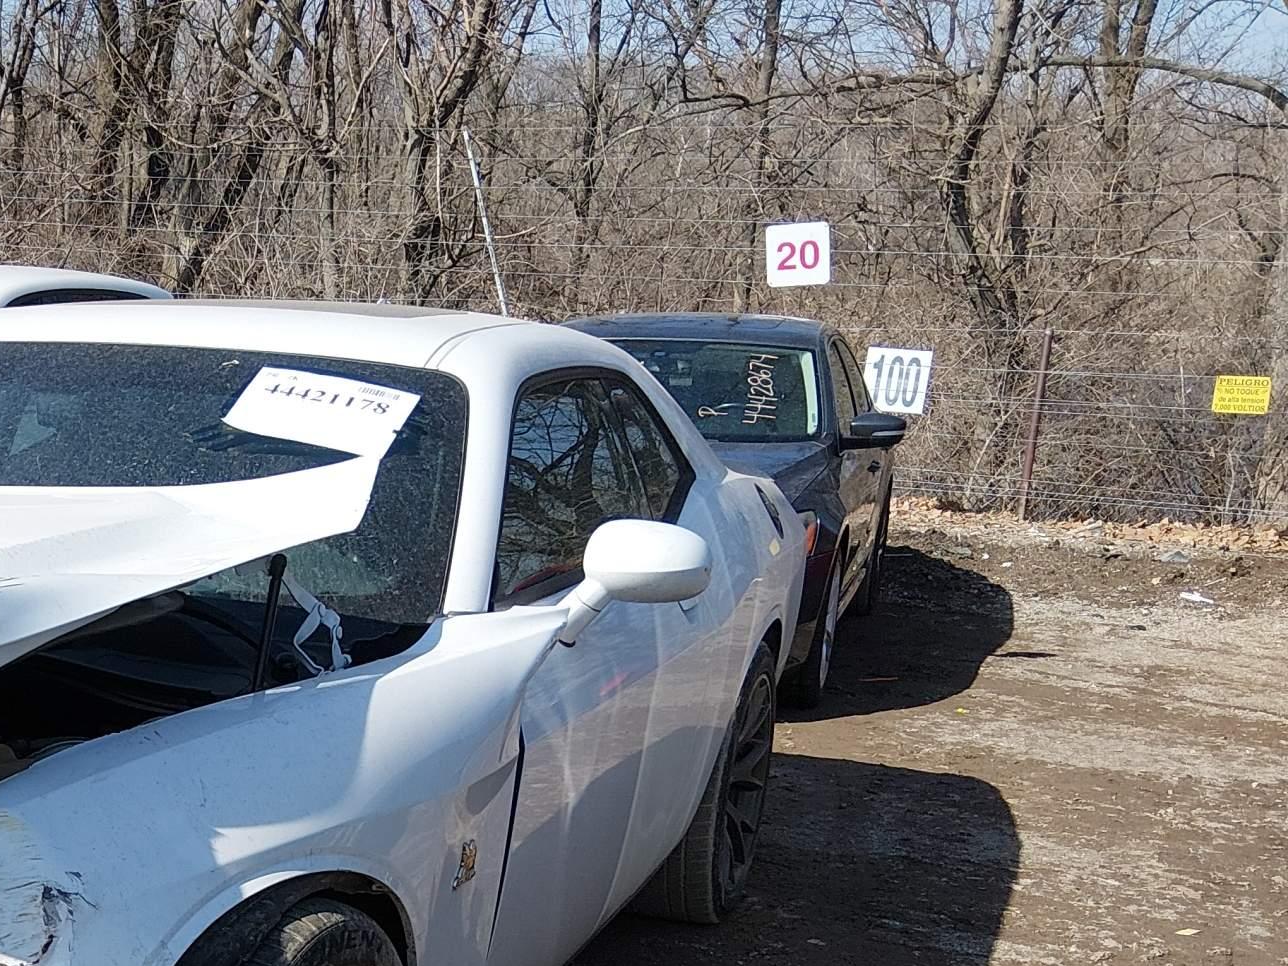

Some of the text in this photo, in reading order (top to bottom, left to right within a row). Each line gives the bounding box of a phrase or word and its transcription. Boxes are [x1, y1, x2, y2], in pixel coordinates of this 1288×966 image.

[777, 240, 819, 271] 20
[742, 353, 778, 424] 44428674
[873, 354, 921, 408] 100
[1219, 378, 1269, 387] PELIGRO
[264, 383, 390, 415] 44421178
[1233, 404, 1265, 412] VOLTIOS
